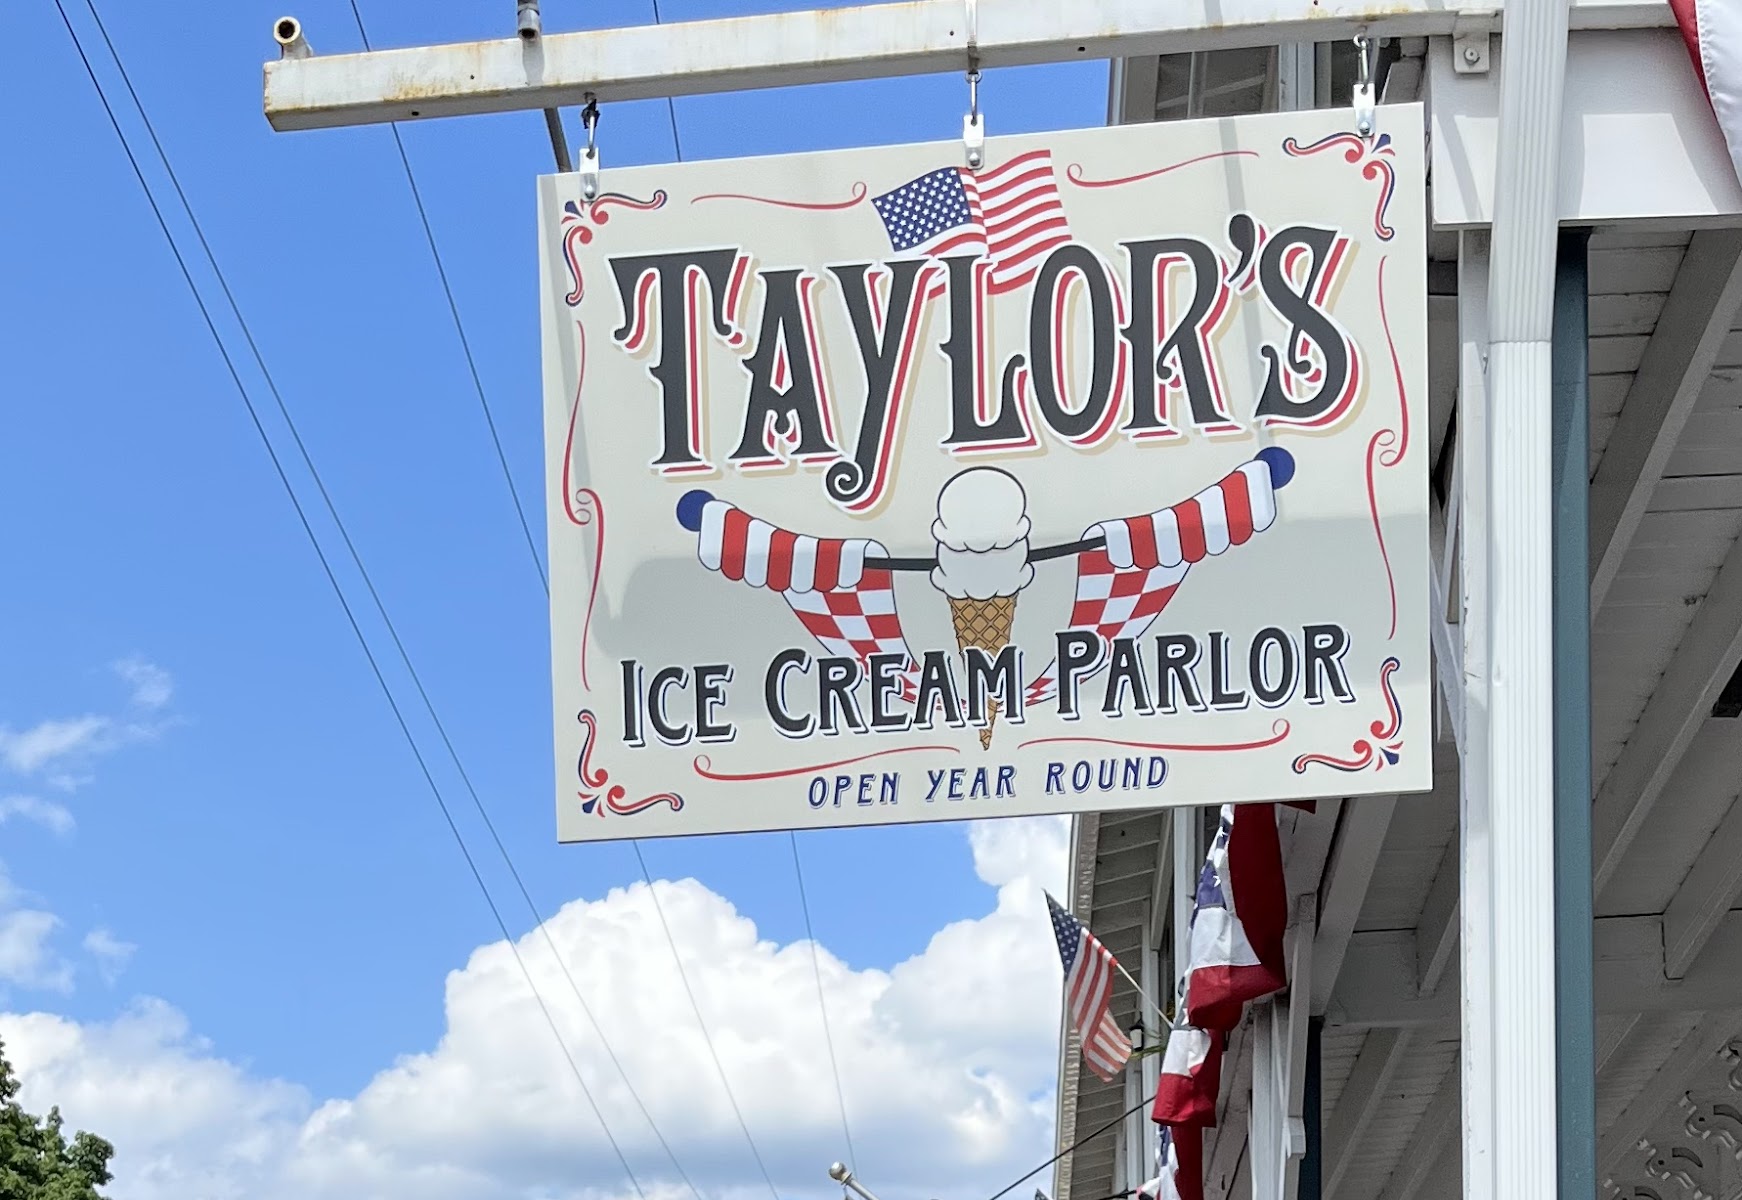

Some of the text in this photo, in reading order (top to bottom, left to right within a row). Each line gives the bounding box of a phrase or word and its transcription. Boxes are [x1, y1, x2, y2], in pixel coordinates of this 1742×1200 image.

[606, 213, 1358, 512] TAYLOR'S
[620, 624, 1356, 746] ICE CREAM PARLOR
[807, 756, 1169, 808] OPEN YEAR ROUND
